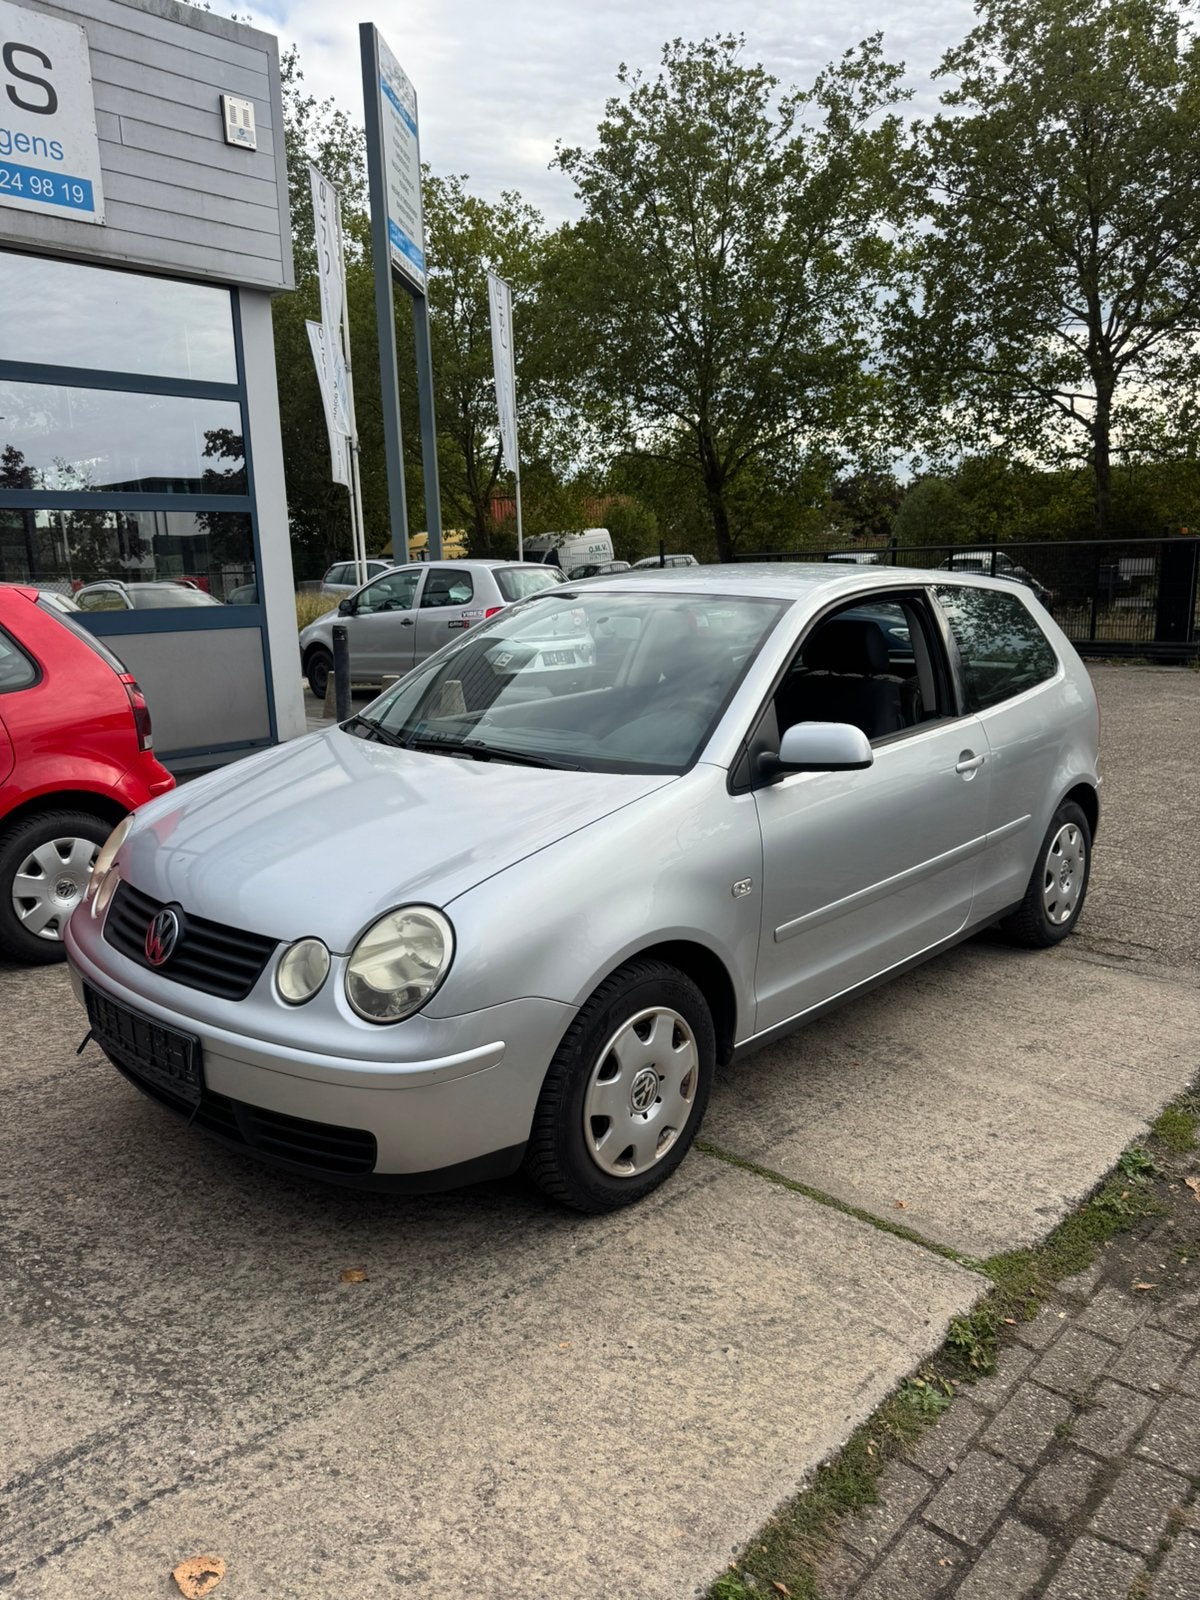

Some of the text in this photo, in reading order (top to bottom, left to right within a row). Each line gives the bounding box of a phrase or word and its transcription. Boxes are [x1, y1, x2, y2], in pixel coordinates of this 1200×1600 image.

[2, 41, 58, 115] S
[0, 128, 64, 160] gens
[0, 169, 84, 203] 24 98 19
